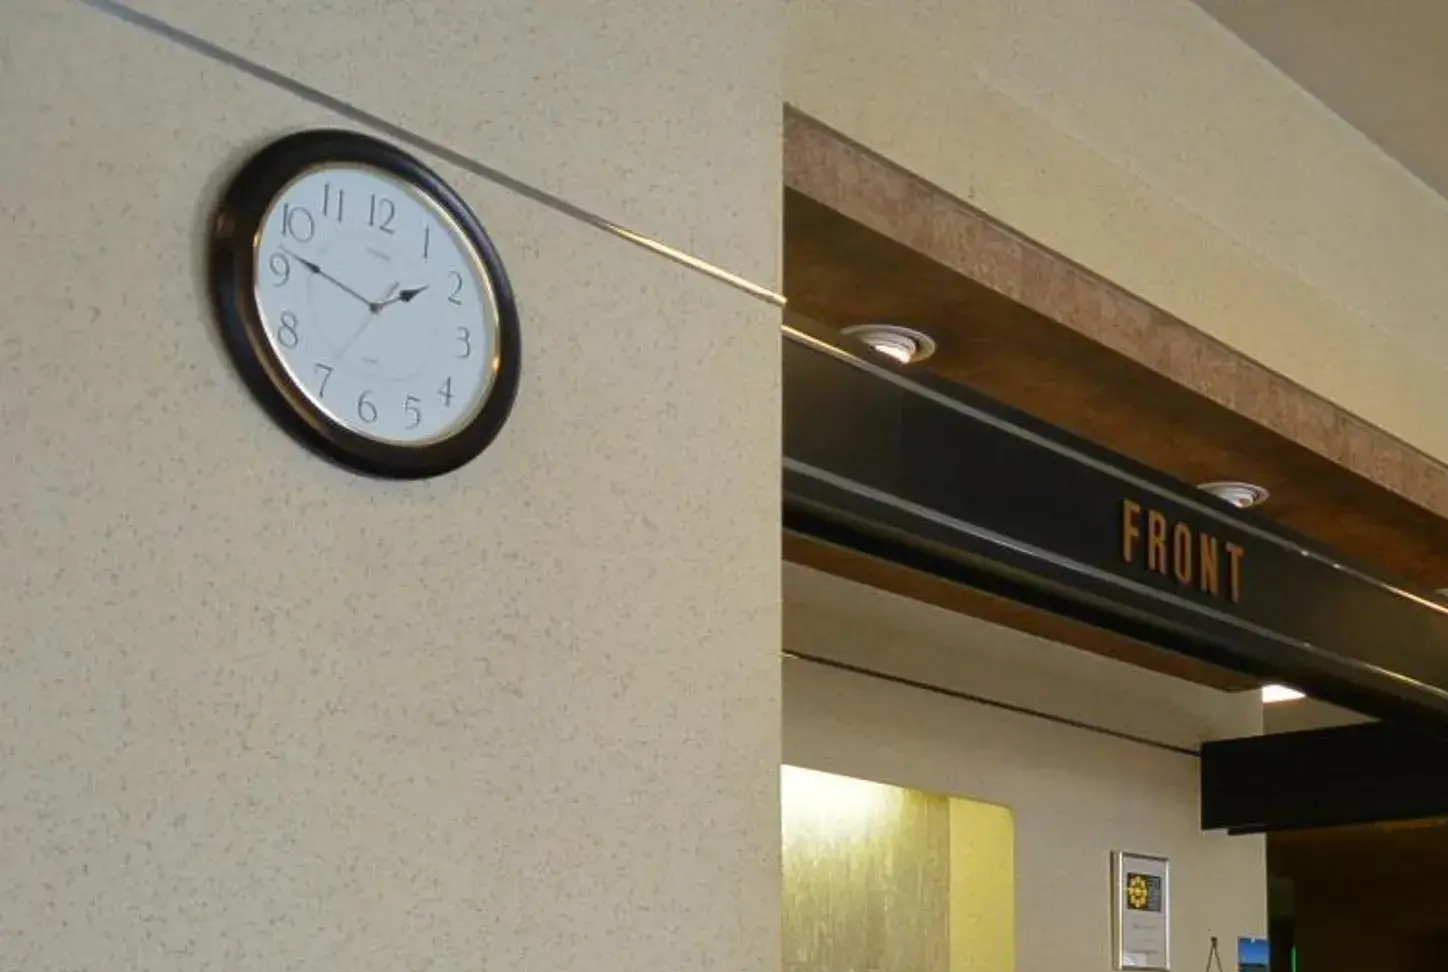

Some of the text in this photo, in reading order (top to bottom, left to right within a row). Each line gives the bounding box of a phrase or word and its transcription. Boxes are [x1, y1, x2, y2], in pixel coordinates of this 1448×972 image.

[321, 181, 345, 223] 11
[367, 192, 397, 235] 12
[280, 202, 316, 243] 10
[422, 225, 432, 259] 1
[268, 252, 292, 288] 9
[446, 270, 464, 307] 2
[276, 310, 300, 350] 8
[455, 326, 472, 359] 3
[313, 362, 335, 398] 7
[438, 376, 456, 408] 4
[356, 389, 379, 424] 6
[402, 394, 423, 430] 5
[1122, 499, 1244, 602] FRONT
